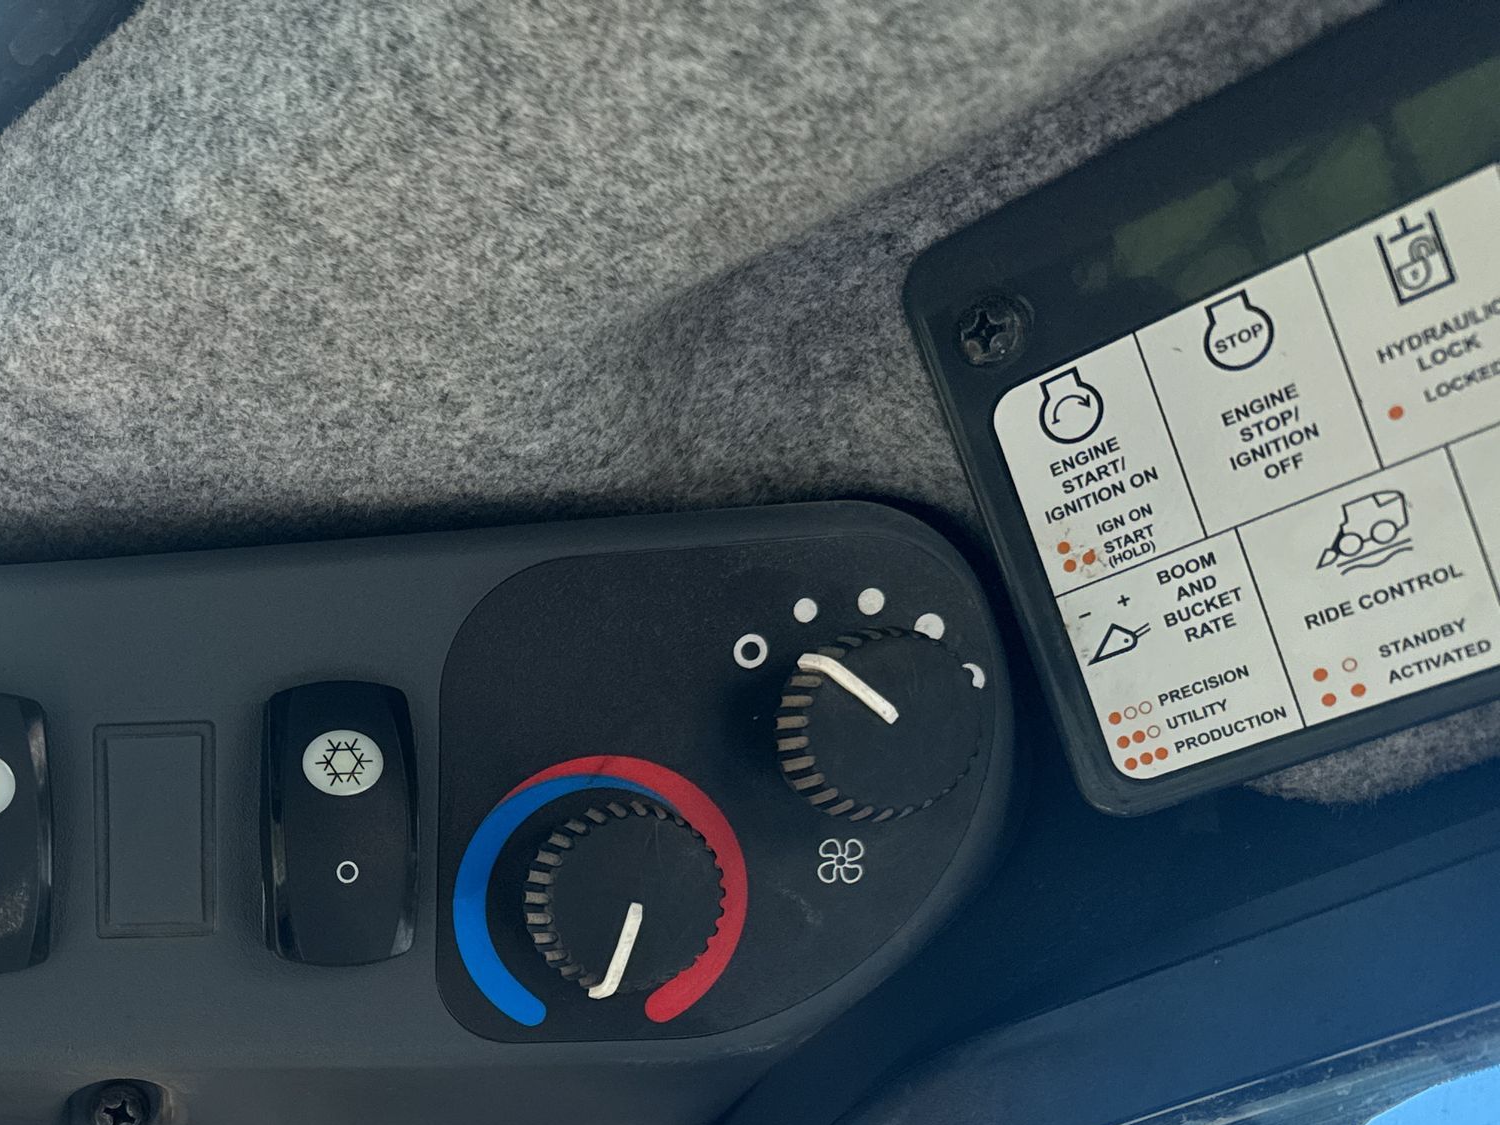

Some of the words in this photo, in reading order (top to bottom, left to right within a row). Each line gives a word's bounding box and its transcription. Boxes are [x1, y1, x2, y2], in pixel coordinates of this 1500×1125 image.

[1214, 323, 1264, 354] STOP
[1416, 333, 1482, 372] LOCK
[1221, 383, 1299, 427] ENGINE
[1239, 406, 1299, 443] STOP/
[1049, 436, 1121, 478] ENGINE
[1229, 423, 1320, 471] IGNITION
[1264, 452, 1304, 479] OFF
[1061, 455, 1125, 495] START/
[1044, 480, 1126, 525] IGNITION
[1129, 466, 1159, 489] ON
[1096, 514, 1126, 536] IGN
[1128, 503, 1153, 522] ON
[1103, 523, 1153, 554] START
[1108, 540, 1156, 569] (HOLD)
[1156, 551, 1217, 586] BOOM
[1176, 574, 1217, 602] AND
[1304, 600, 1355, 631] RIDE
[1358, 563, 1464, 611] CONTROL
[1163, 587, 1242, 629] BUCKET
[1184, 612, 1237, 644] RATE
[1378, 617, 1466, 659] STANDBY
[1388, 639, 1492, 684] ACTIVATED
[1157, 664, 1250, 708] PRECISION
[1165, 698, 1228, 731] UTILITY
[1174, 706, 1288, 754] PRODUCTION
